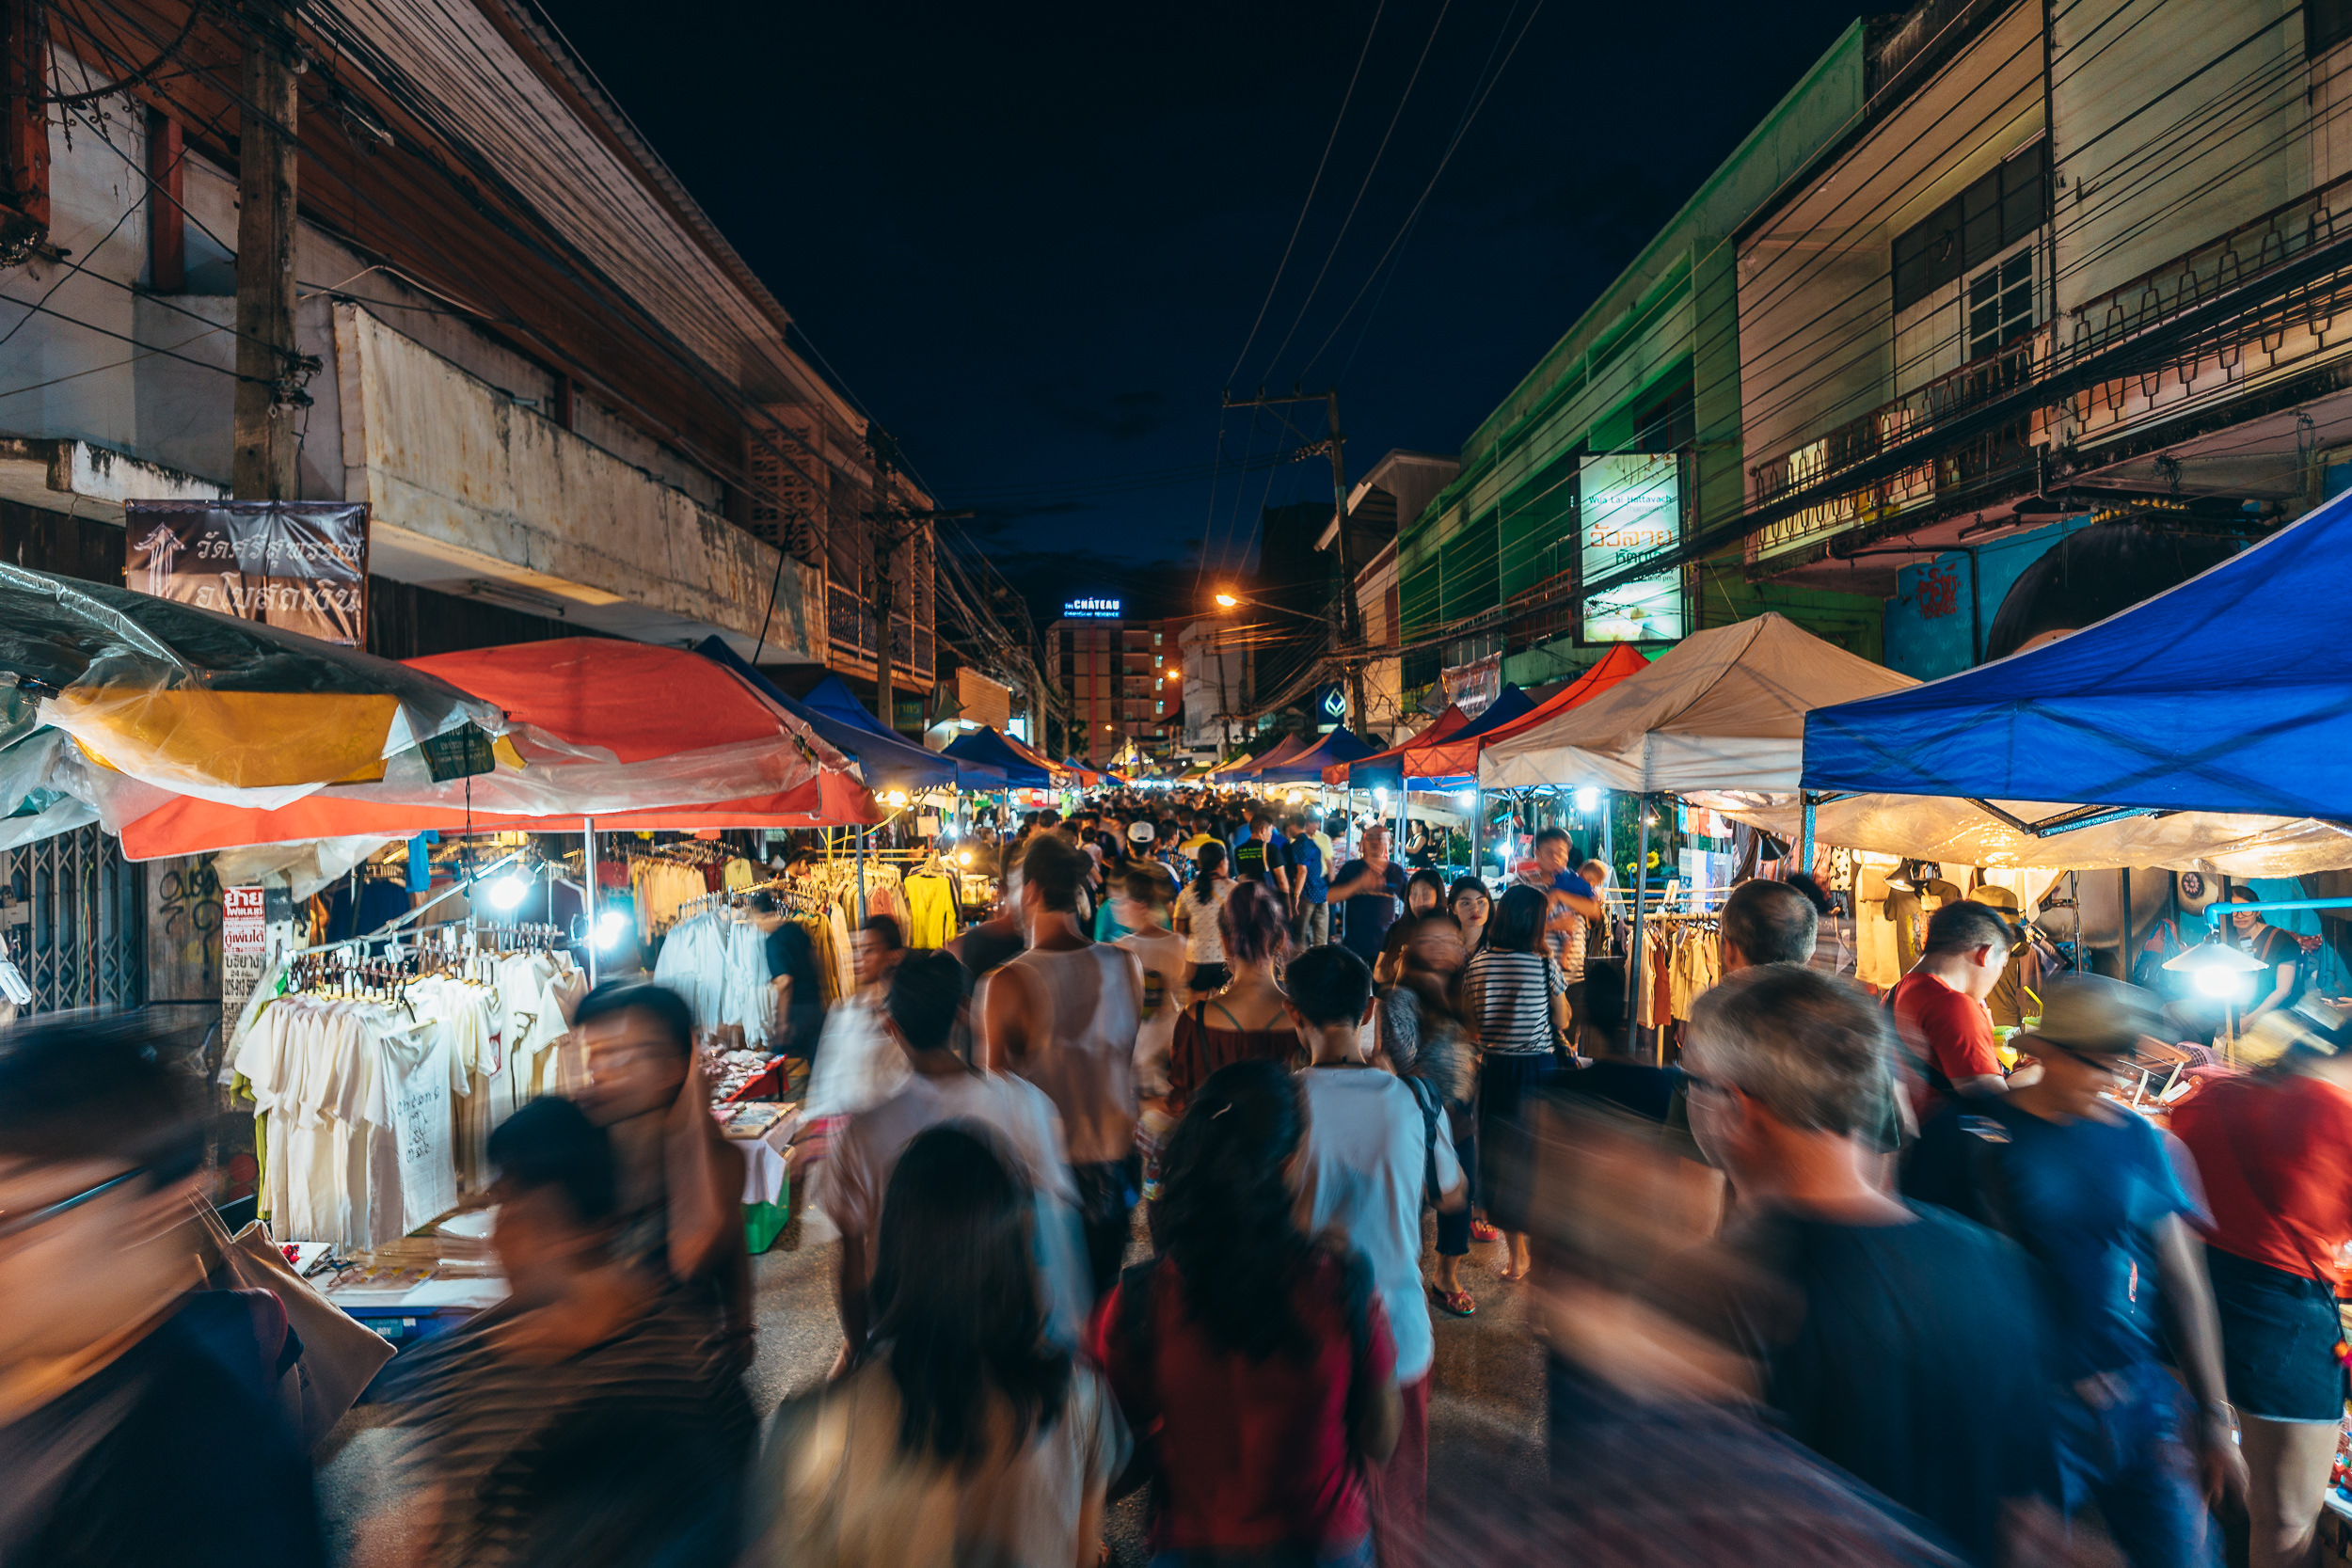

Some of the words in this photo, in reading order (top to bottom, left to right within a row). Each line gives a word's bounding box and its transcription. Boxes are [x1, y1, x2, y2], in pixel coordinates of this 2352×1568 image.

[1591, 523, 1673, 547] วัวลาย
[197, 531, 362, 569] วัดศรีสุพรรณ
[224, 889, 263, 906] ย้าย
